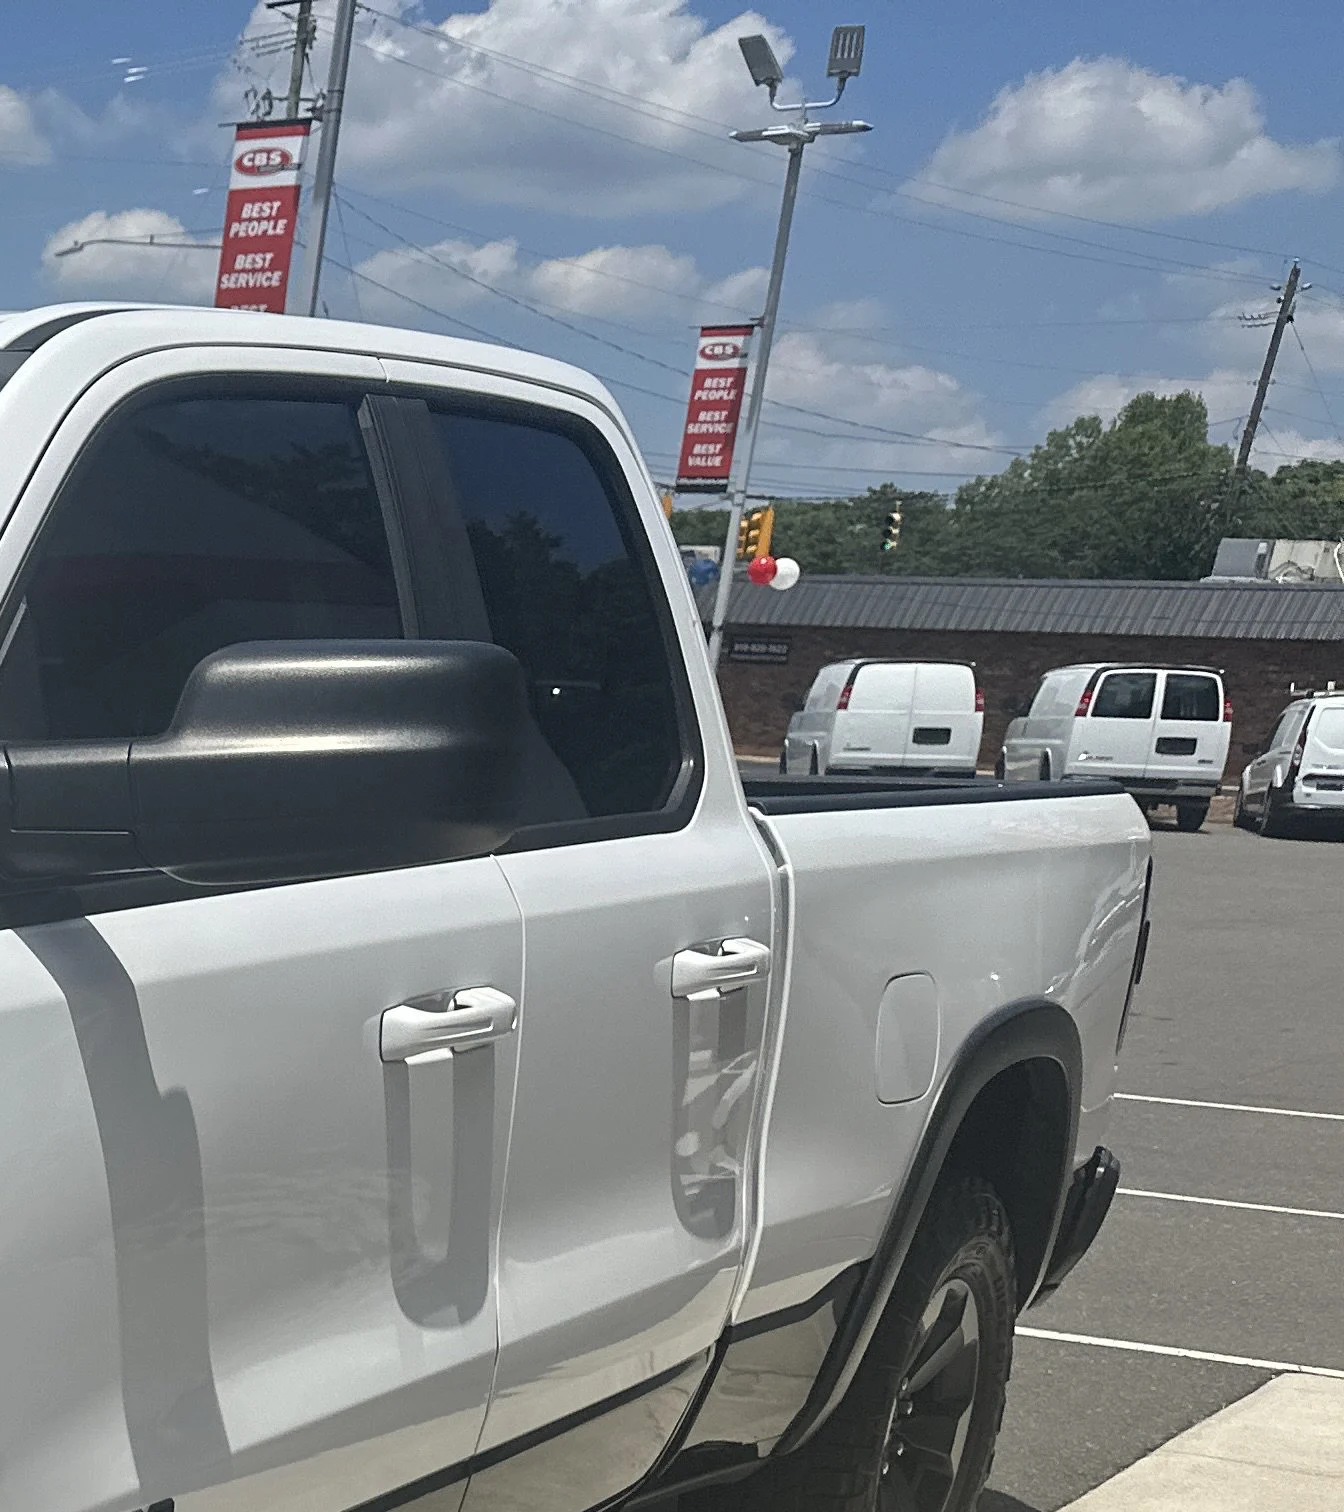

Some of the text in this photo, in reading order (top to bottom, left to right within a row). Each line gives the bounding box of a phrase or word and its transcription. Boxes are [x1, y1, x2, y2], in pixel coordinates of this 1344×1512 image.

[241, 151, 284, 168] CBS
[240, 201, 281, 219] BEST
[229, 219, 288, 239] PEOPLE
[234, 252, 274, 270] BEST
[220, 271, 283, 289] SERVICE
[704, 344, 734, 355] CBS
[703, 377, 734, 388] BEST
[694, 389, 737, 401] PEOPLE
[698, 410, 728, 422] BEST
[687, 422, 734, 434] SERVICE
[693, 443, 722, 455] BEST
[688, 455, 723, 467] VALUE
